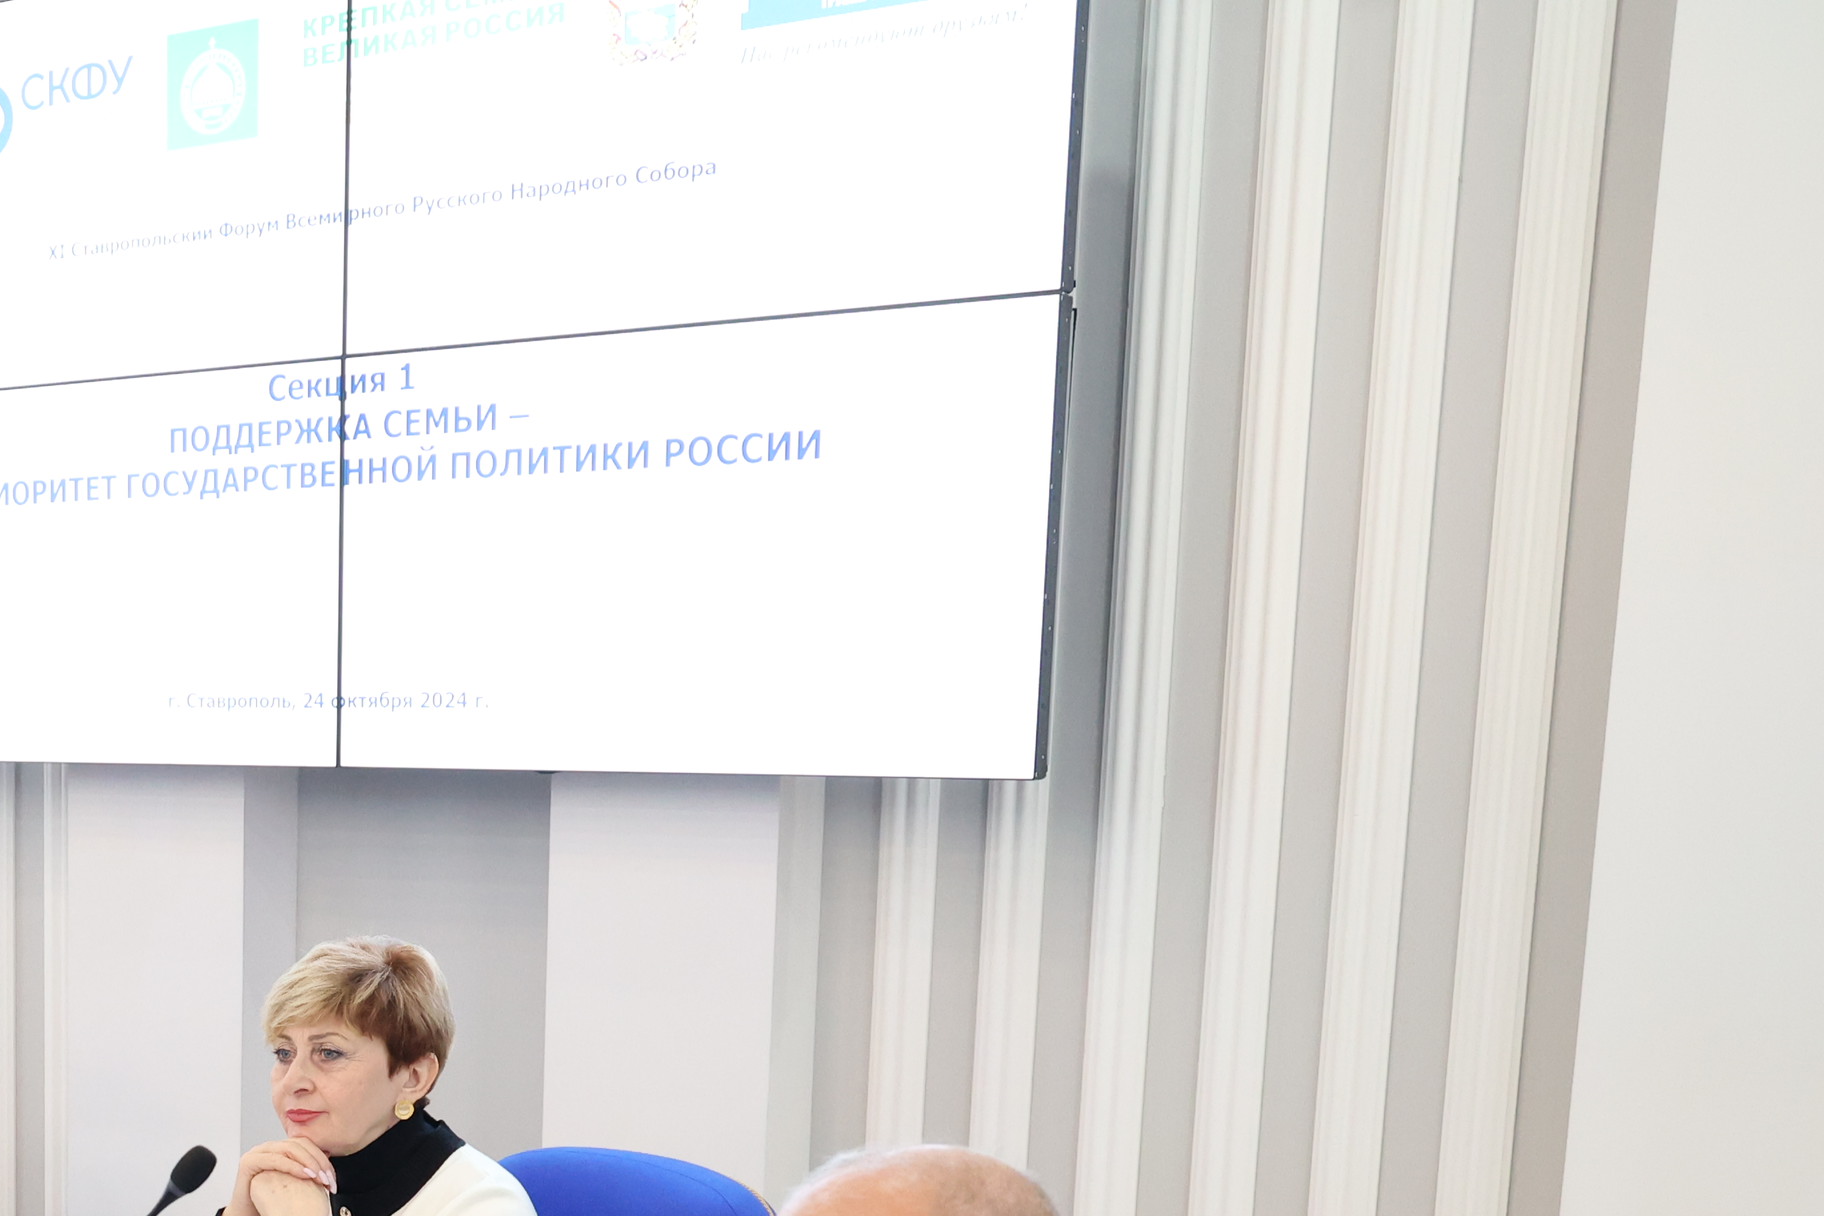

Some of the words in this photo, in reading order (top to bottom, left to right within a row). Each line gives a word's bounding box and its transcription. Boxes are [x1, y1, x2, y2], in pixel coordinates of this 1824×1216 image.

[303, 24, 437, 67] ВЕЛИКАЯ
[446, 2, 565, 42] РОССИЯ
[21, 55, 133, 110] СКФУ
[219, 220, 279, 239] Форум
[286, 202, 406, 230] Всемирного
[412, 188, 504, 216] Русского
[511, 172, 628, 201] Народного
[636, 160, 717, 184] Собора
[268, 371, 387, 402] Секция
[400, 363, 416, 390] 1
[169, 413, 373, 456] ПОДДЕРЖКА
[383, 403, 497, 438] СЕМЬИ
[126, 445, 437, 500] ГОСУДАРСТВЕННОЙ
[451, 440, 650, 480] ПОЛИТИКИ
[665, 429, 822, 468] РОССИИ
[186, 692, 296, 713] Ставрополь,
[303, 693, 325, 709] 24
[330, 691, 413, 713] октября
[420, 692, 468, 709] 2024
